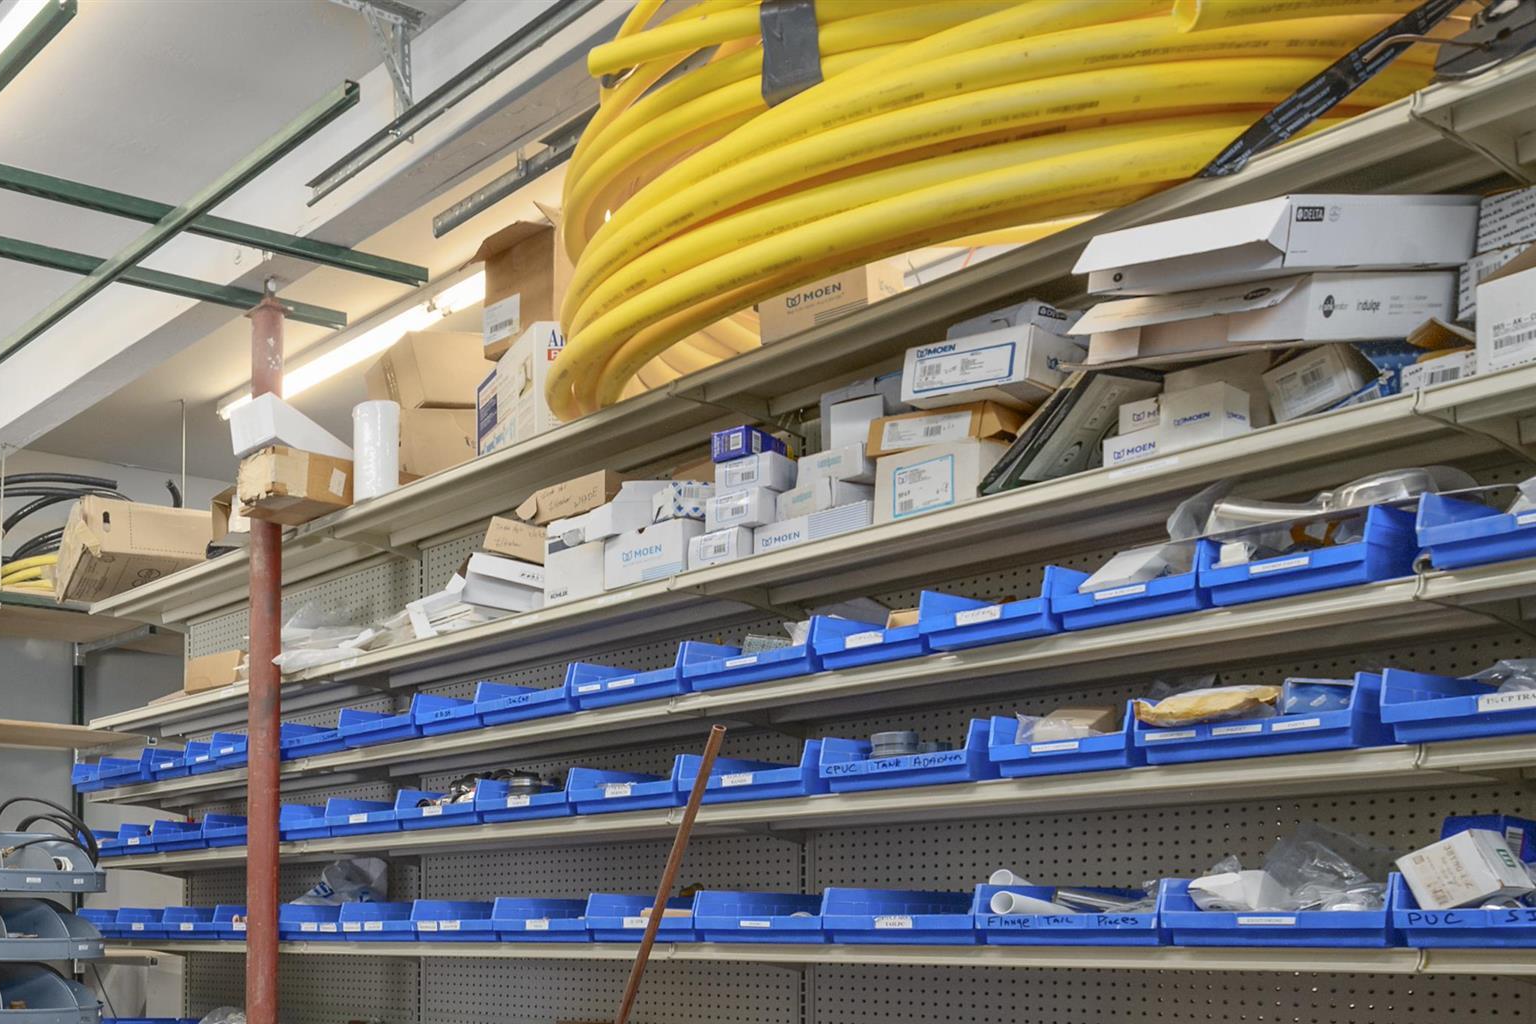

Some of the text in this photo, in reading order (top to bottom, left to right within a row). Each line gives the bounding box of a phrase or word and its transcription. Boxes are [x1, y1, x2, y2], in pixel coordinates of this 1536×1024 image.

[1304, 207, 1325, 221] DELTA
[804, 282, 842, 303] MOEN
[928, 343, 956, 356] MOEN
[1183, 411, 1211, 425] MOEN
[1126, 441, 1156, 456] MOEN
[773, 530, 801, 544] MOEN
[633, 543, 663, 559] MOEN
